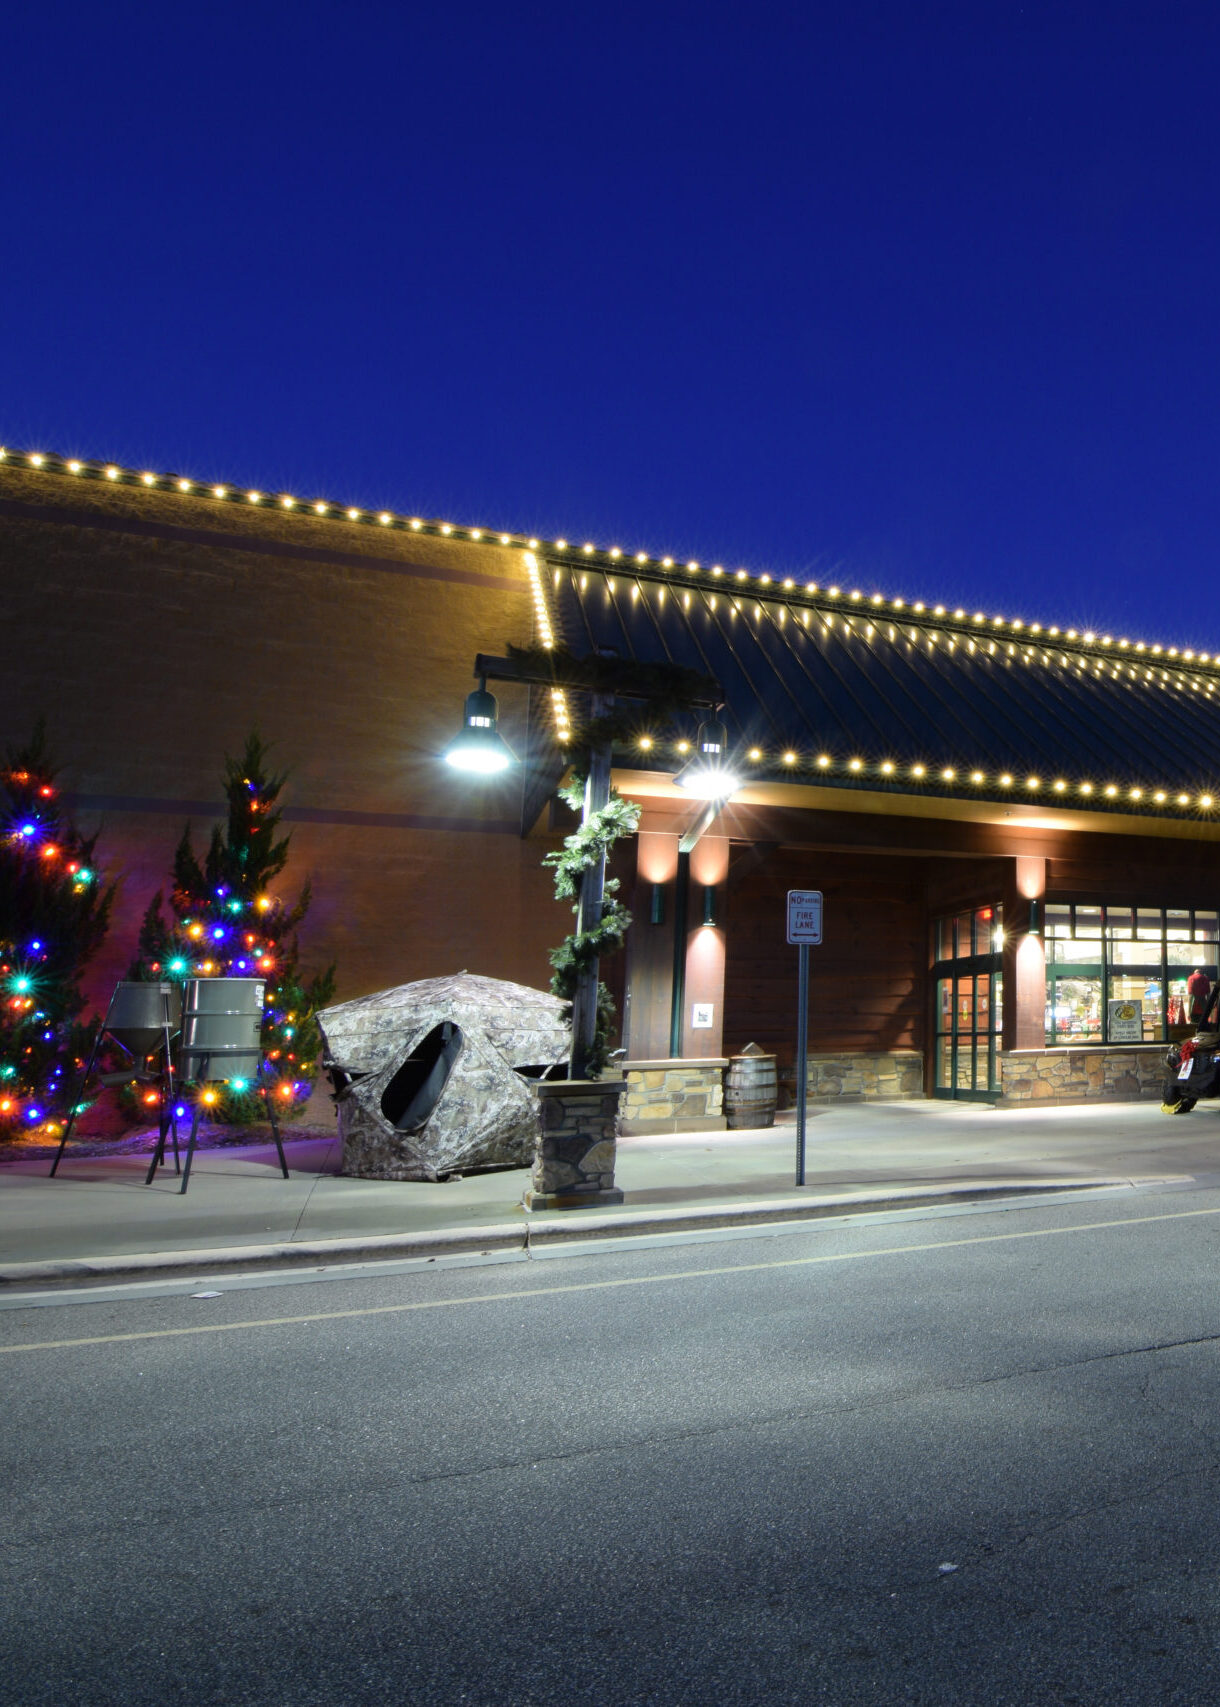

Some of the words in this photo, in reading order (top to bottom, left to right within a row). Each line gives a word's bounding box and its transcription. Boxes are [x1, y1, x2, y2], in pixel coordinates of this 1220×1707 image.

[791, 896, 801, 904] NO
[796, 911, 814, 919] FIRE
[795, 920, 815, 929] LANE
